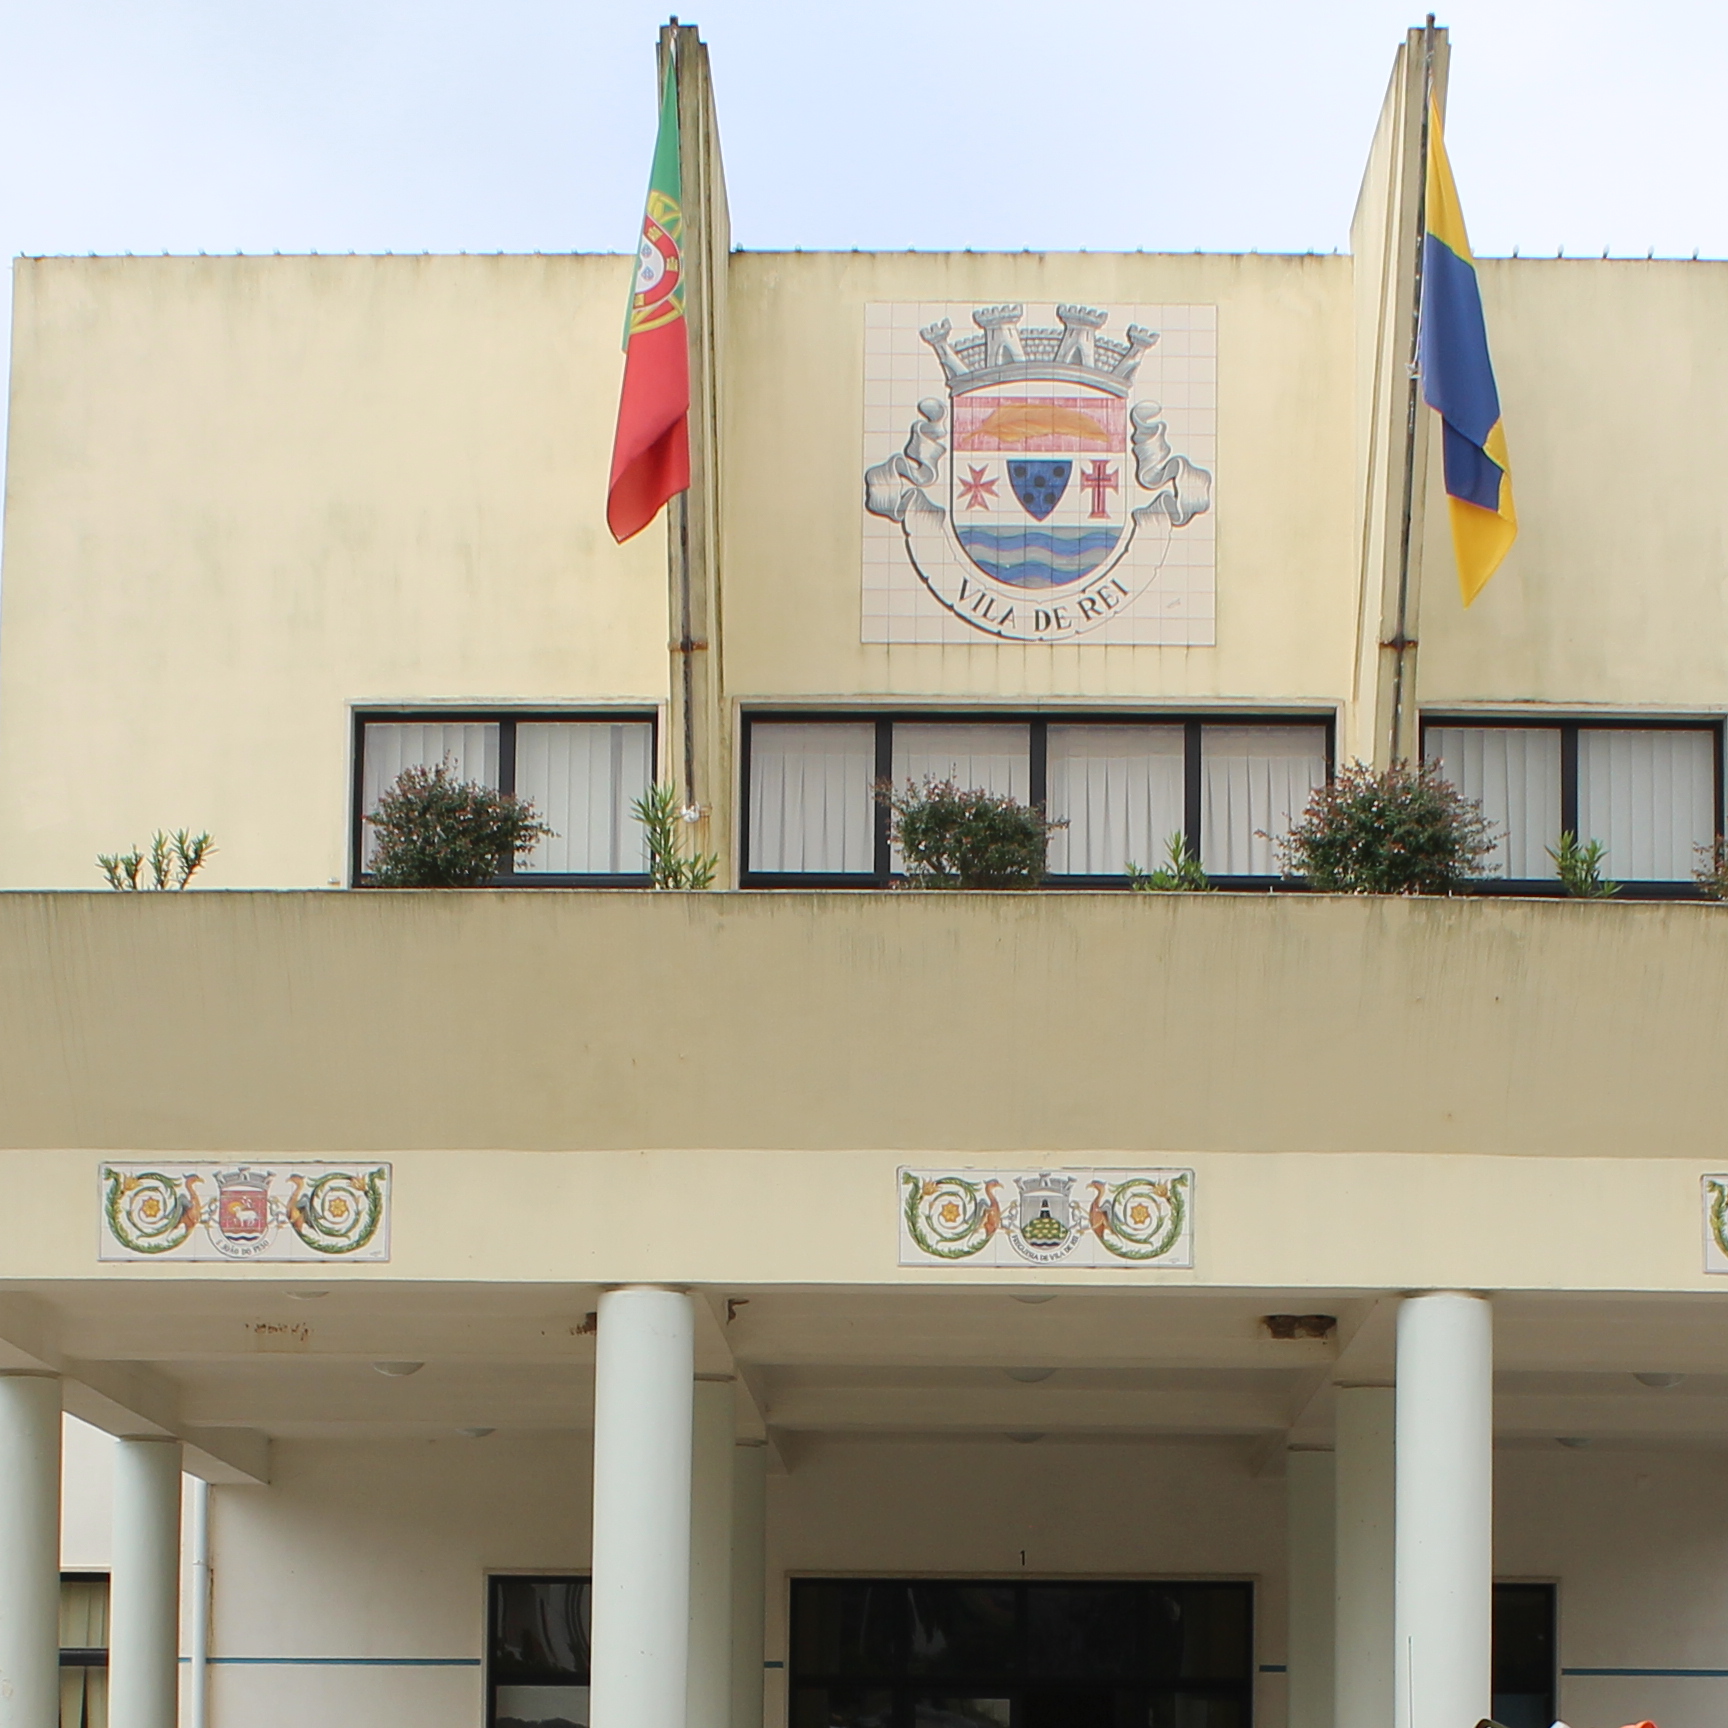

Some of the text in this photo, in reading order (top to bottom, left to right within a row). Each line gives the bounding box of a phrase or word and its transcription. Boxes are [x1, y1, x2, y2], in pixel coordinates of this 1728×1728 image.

[958, 576, 1129, 633] VILA DE REI
[1020, 1550, 1025, 1566] 1
